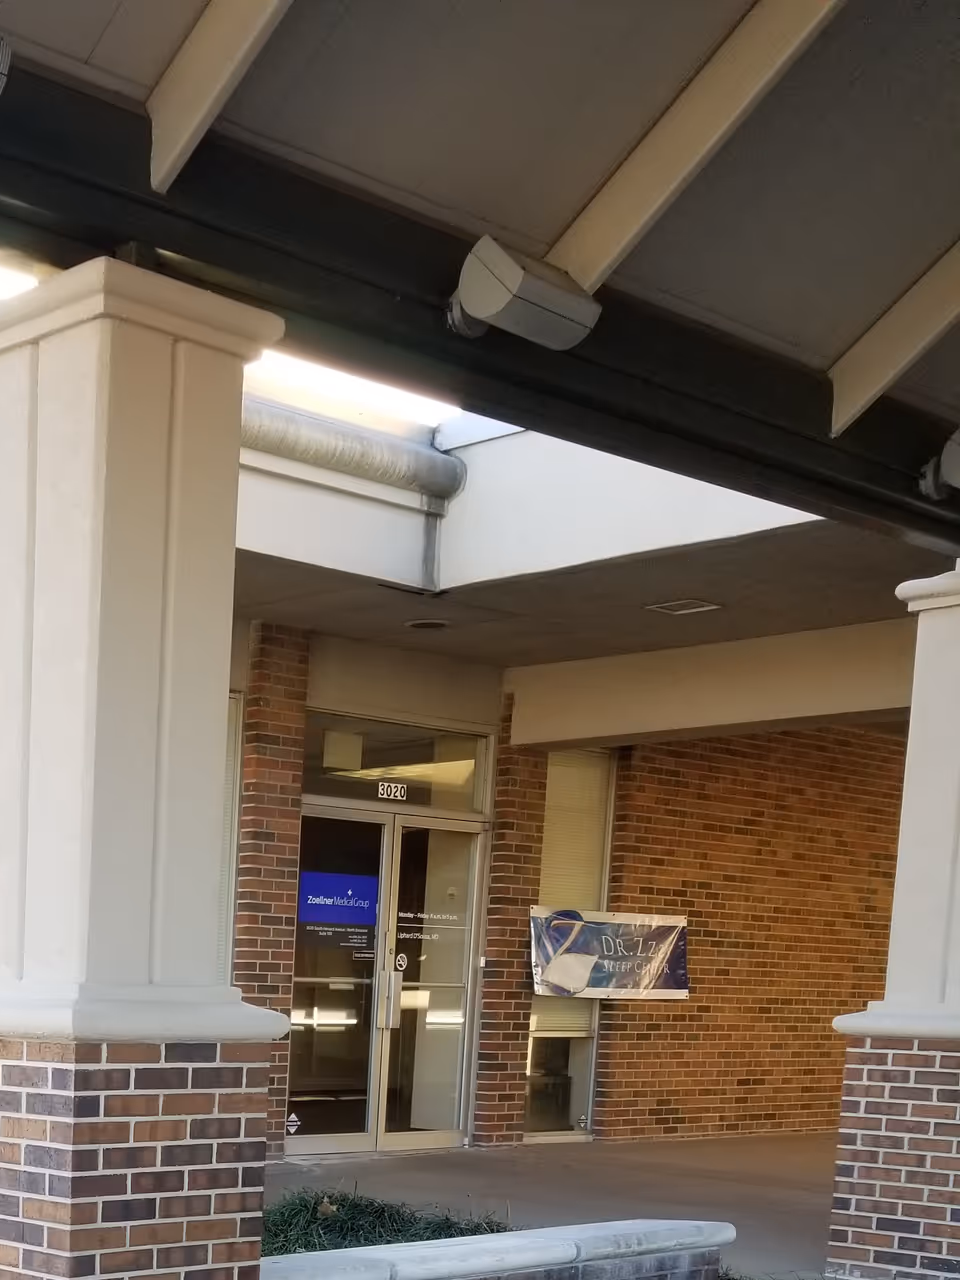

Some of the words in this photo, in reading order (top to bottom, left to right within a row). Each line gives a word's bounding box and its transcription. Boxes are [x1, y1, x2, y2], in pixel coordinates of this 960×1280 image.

[379, 783, 406, 799] 3020
[307, 895, 334, 905] Zoellner
[334, 896, 353, 906] Medical
[353, 897, 370, 909] Group
[398, 911, 414, 919] Monday
[602, 935, 633, 956] DR.
[603, 959, 632, 972] SLEEP
[634, 960, 670, 974] CER
